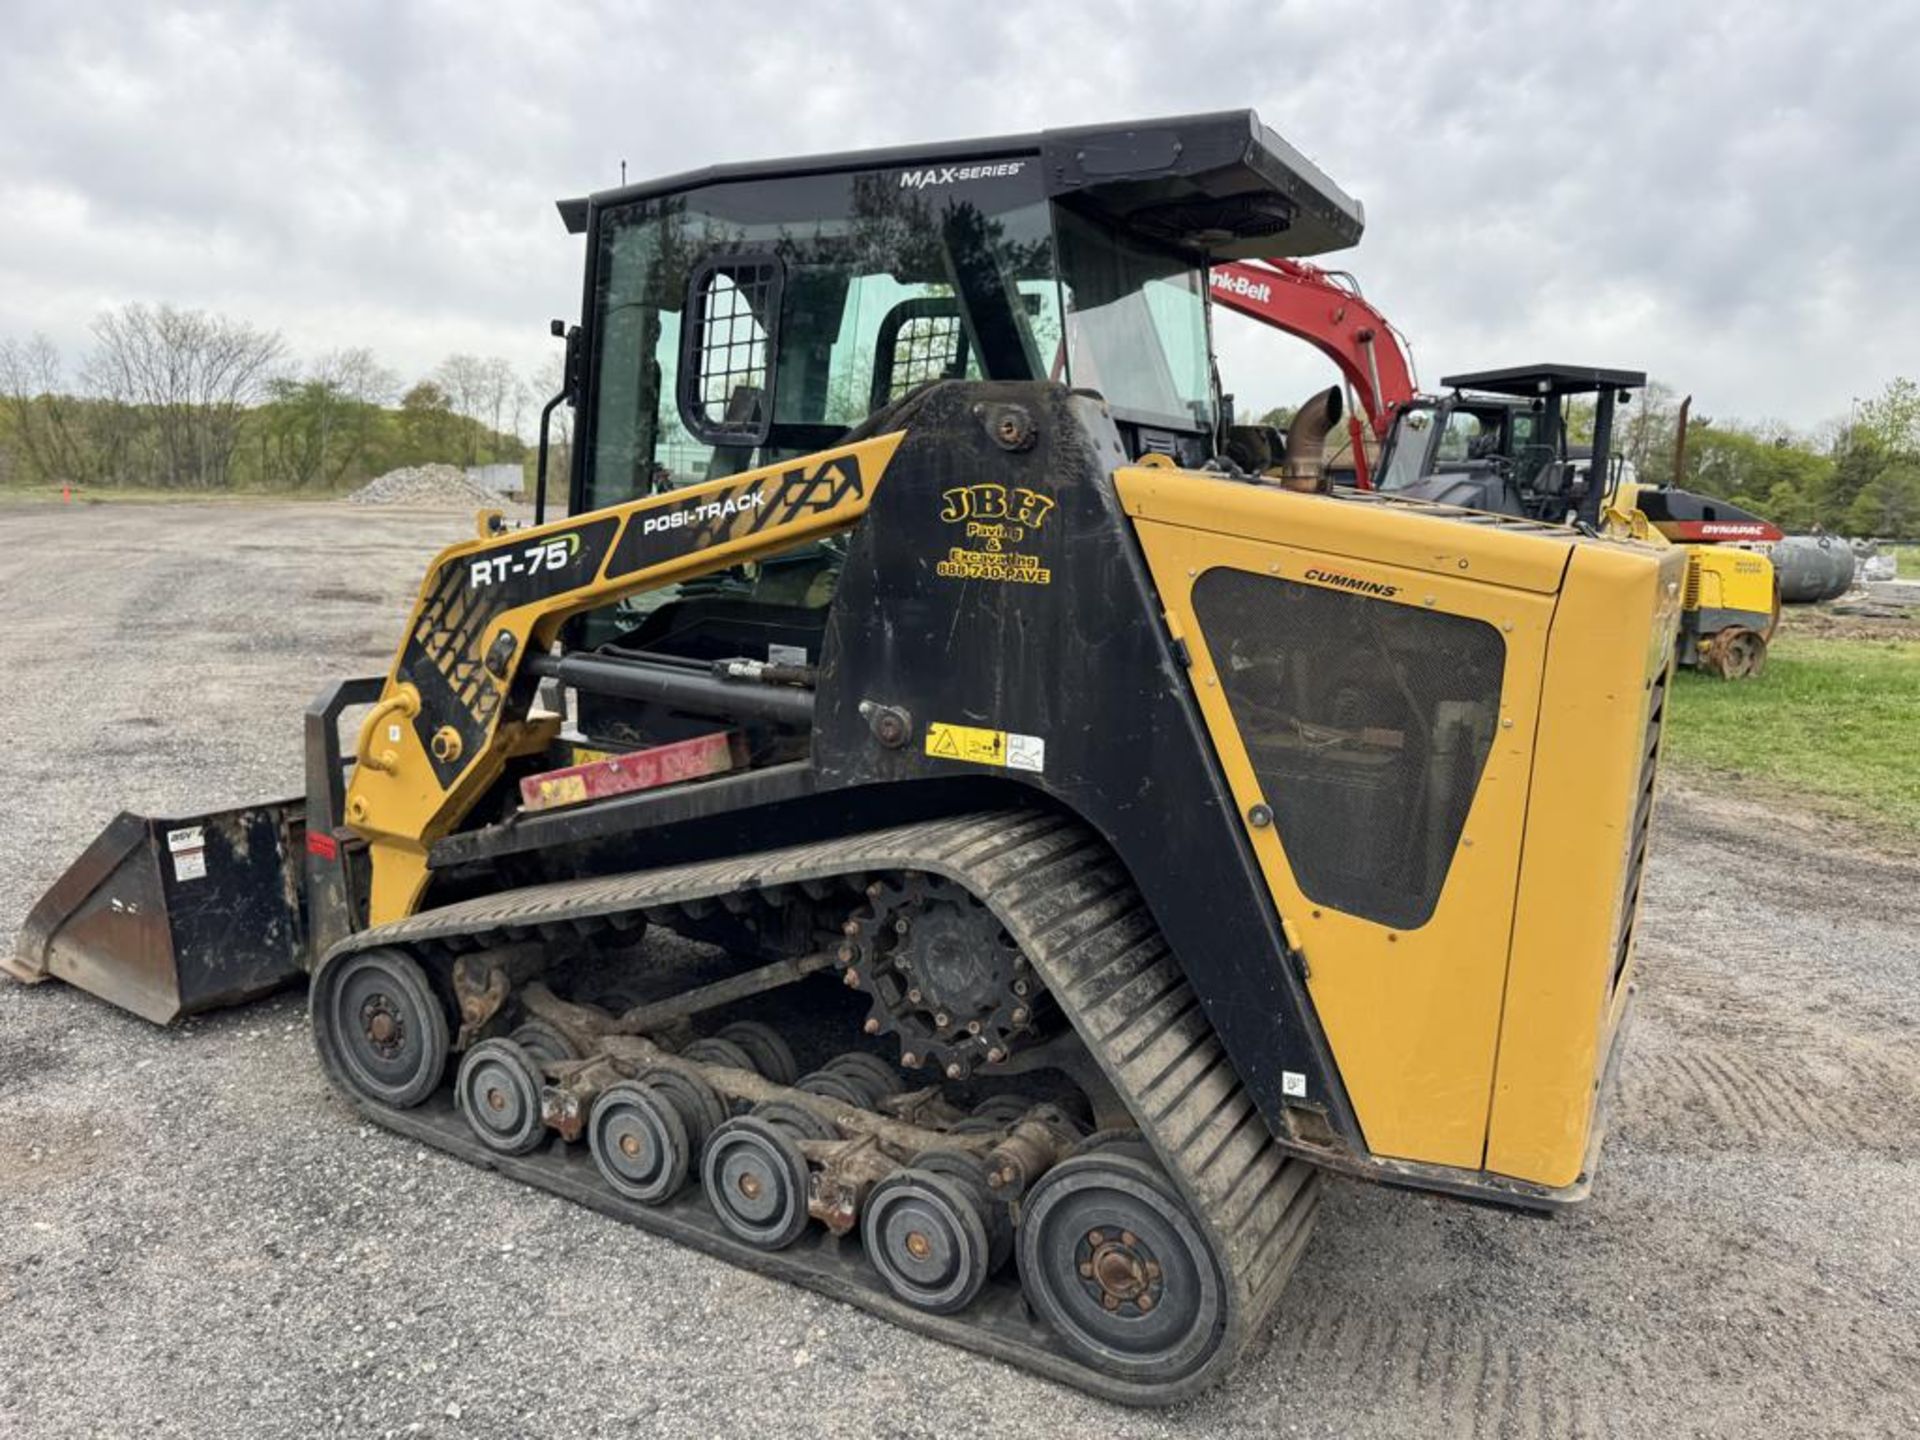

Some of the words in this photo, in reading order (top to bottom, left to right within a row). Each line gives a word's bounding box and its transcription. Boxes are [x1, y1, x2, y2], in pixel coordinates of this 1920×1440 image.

[900, 163, 1021, 189] MAX-SERIES
[644, 491, 766, 535] POSI-TRACK
[1702, 525, 1765, 536] DYNAPAC
[470, 541, 568, 588] RT-75
[1304, 569, 1398, 597] CUMMINS
